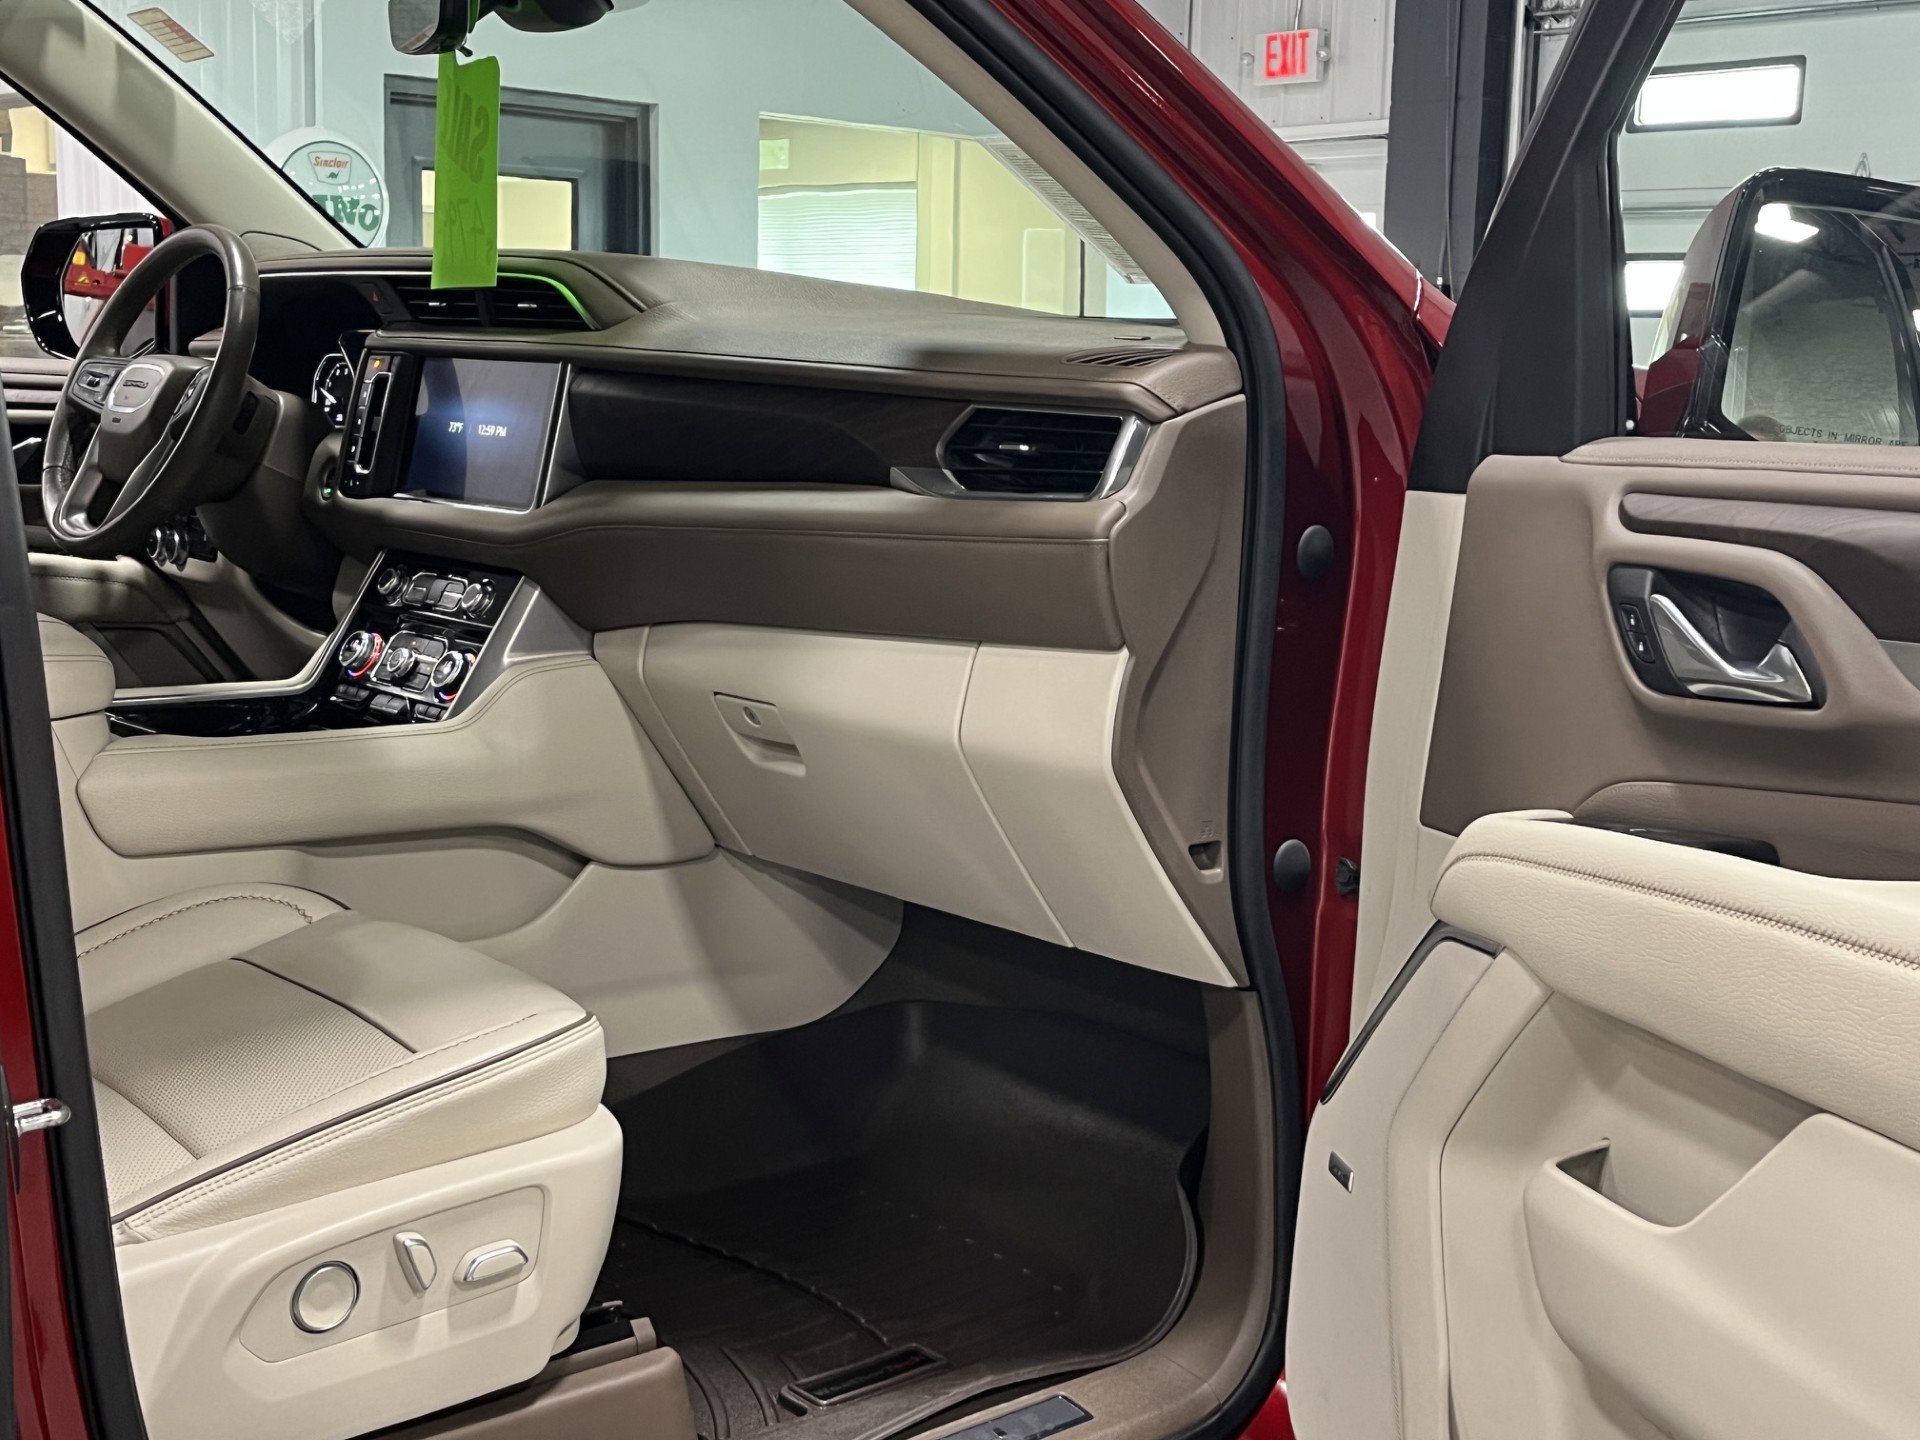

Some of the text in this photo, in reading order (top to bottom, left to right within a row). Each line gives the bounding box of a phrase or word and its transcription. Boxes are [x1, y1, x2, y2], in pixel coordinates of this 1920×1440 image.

[1265, 32, 1310, 77] EXIT
[313, 156, 349, 169] Sinclair
[495, 425, 507, 437] PM
[1780, 424, 1822, 438] OBJECTS
[1828, 431, 1838, 440] IN
[1844, 432, 1882, 446] MIRROR
